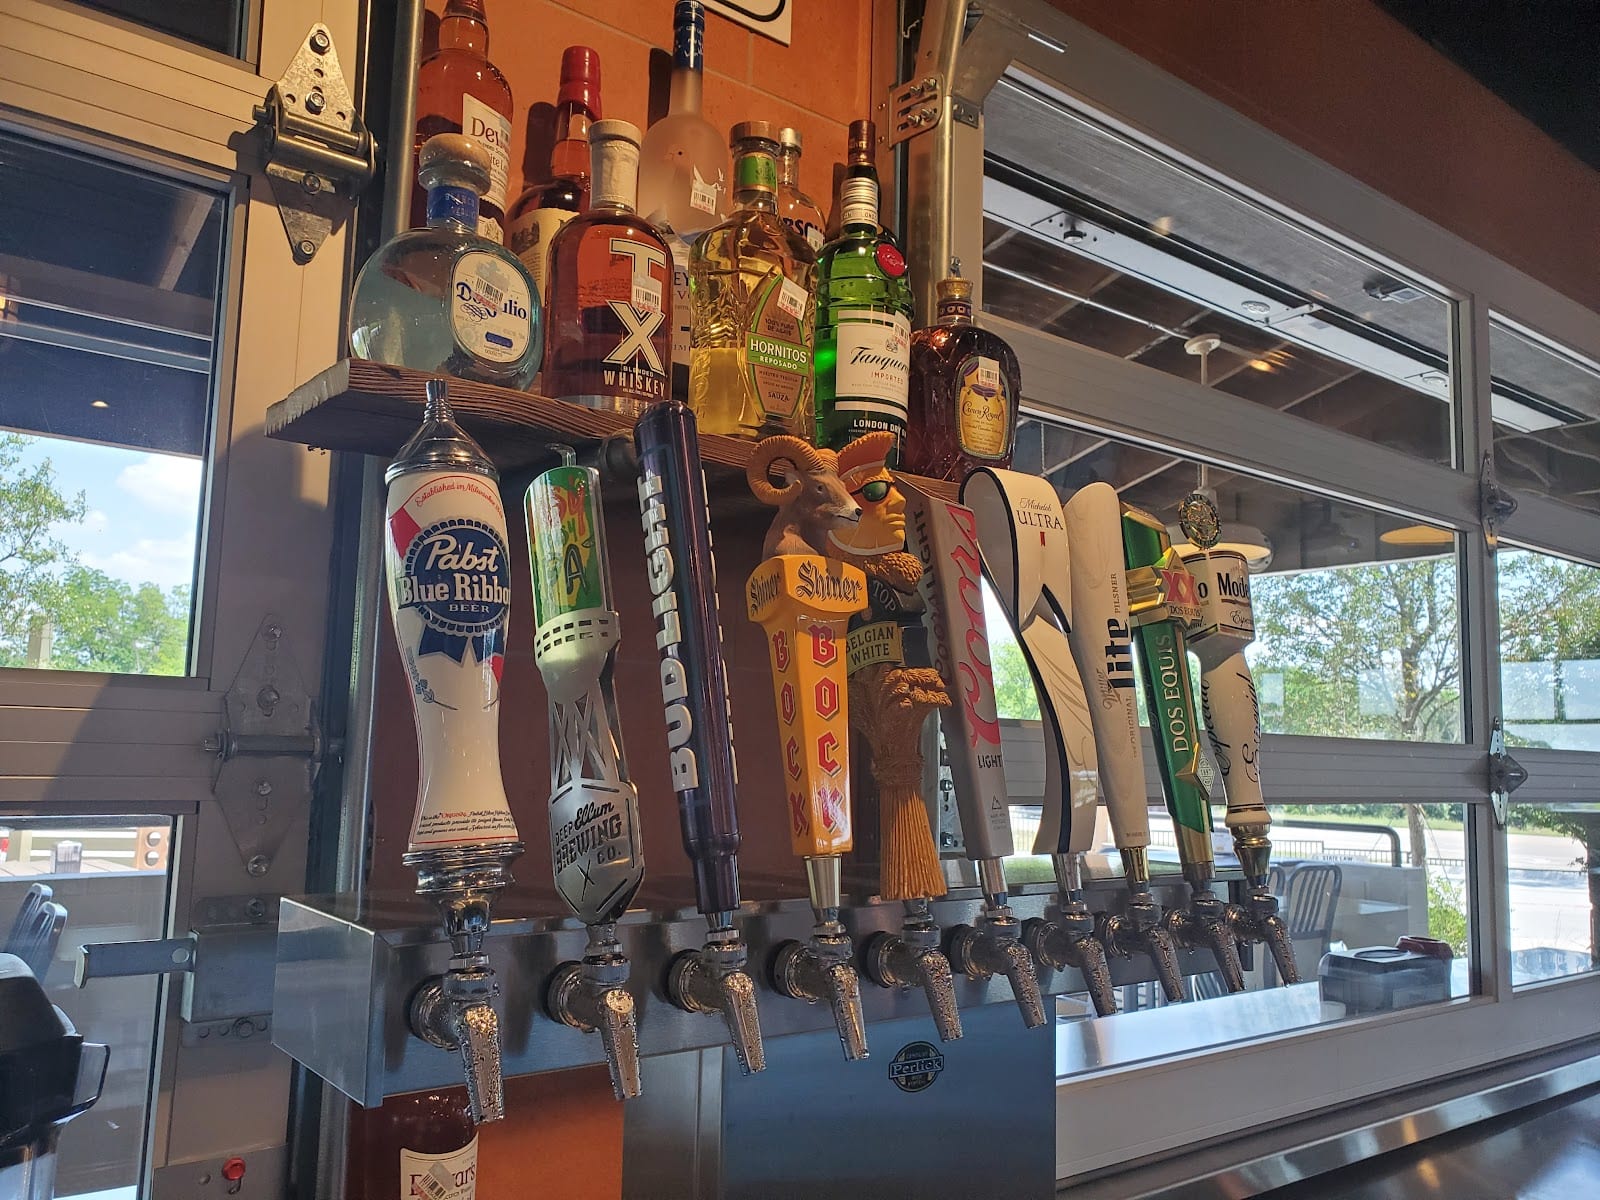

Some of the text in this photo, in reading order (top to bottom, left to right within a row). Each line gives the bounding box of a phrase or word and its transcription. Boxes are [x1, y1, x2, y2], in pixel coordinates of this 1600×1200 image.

[471, 116, 500, 146] De
[674, 271, 690, 287] EY
[750, 338, 807, 364] HORNITOS
[759, 355, 798, 370] REPOSADO
[603, 370, 665, 398] WHISKEY
[622, 365, 654, 378] BLENDED
[871, 372, 904, 385] IMPORTED
[768, 391, 789, 402] SAUZA
[962, 400, 1002, 422] Crown Royal
[853, 419, 888, 430] LONDON
[890, 423, 902, 434] DRY
[415, 482, 455, 508] Established
[1019, 497, 1052, 512] Michelob
[1016, 510, 1064, 530] ULTRA
[423, 534, 499, 572] Pabst
[401, 572, 511, 604] Blue Ribbo
[749, 572, 780, 616] Shiner
[796, 560, 862, 604] Shiner
[872, 579, 897, 611] TOP
[1110, 573, 1121, 614] PILSNER
[1160, 570, 1201, 606] XX
[1216, 571, 1250, 600] Mode
[449, 603, 490, 613] BEER
[637, 474, 699, 793] BUD LIGHT
[850, 643, 890, 666] WHITE
[1155, 634, 1190, 753] DOS EQUIS
[772, 628, 809, 836] BOCK
[807, 624, 843, 834] BOCK
[1125, 695, 1136, 744] ORIGINAL
[977, 754, 1003, 769] LIGHT
[555, 802, 615, 847] DEEP Ellum
[556, 813, 623, 876] BREWING
[596, 845, 622, 865] CO.
[893, 1059, 941, 1075] Perlick
